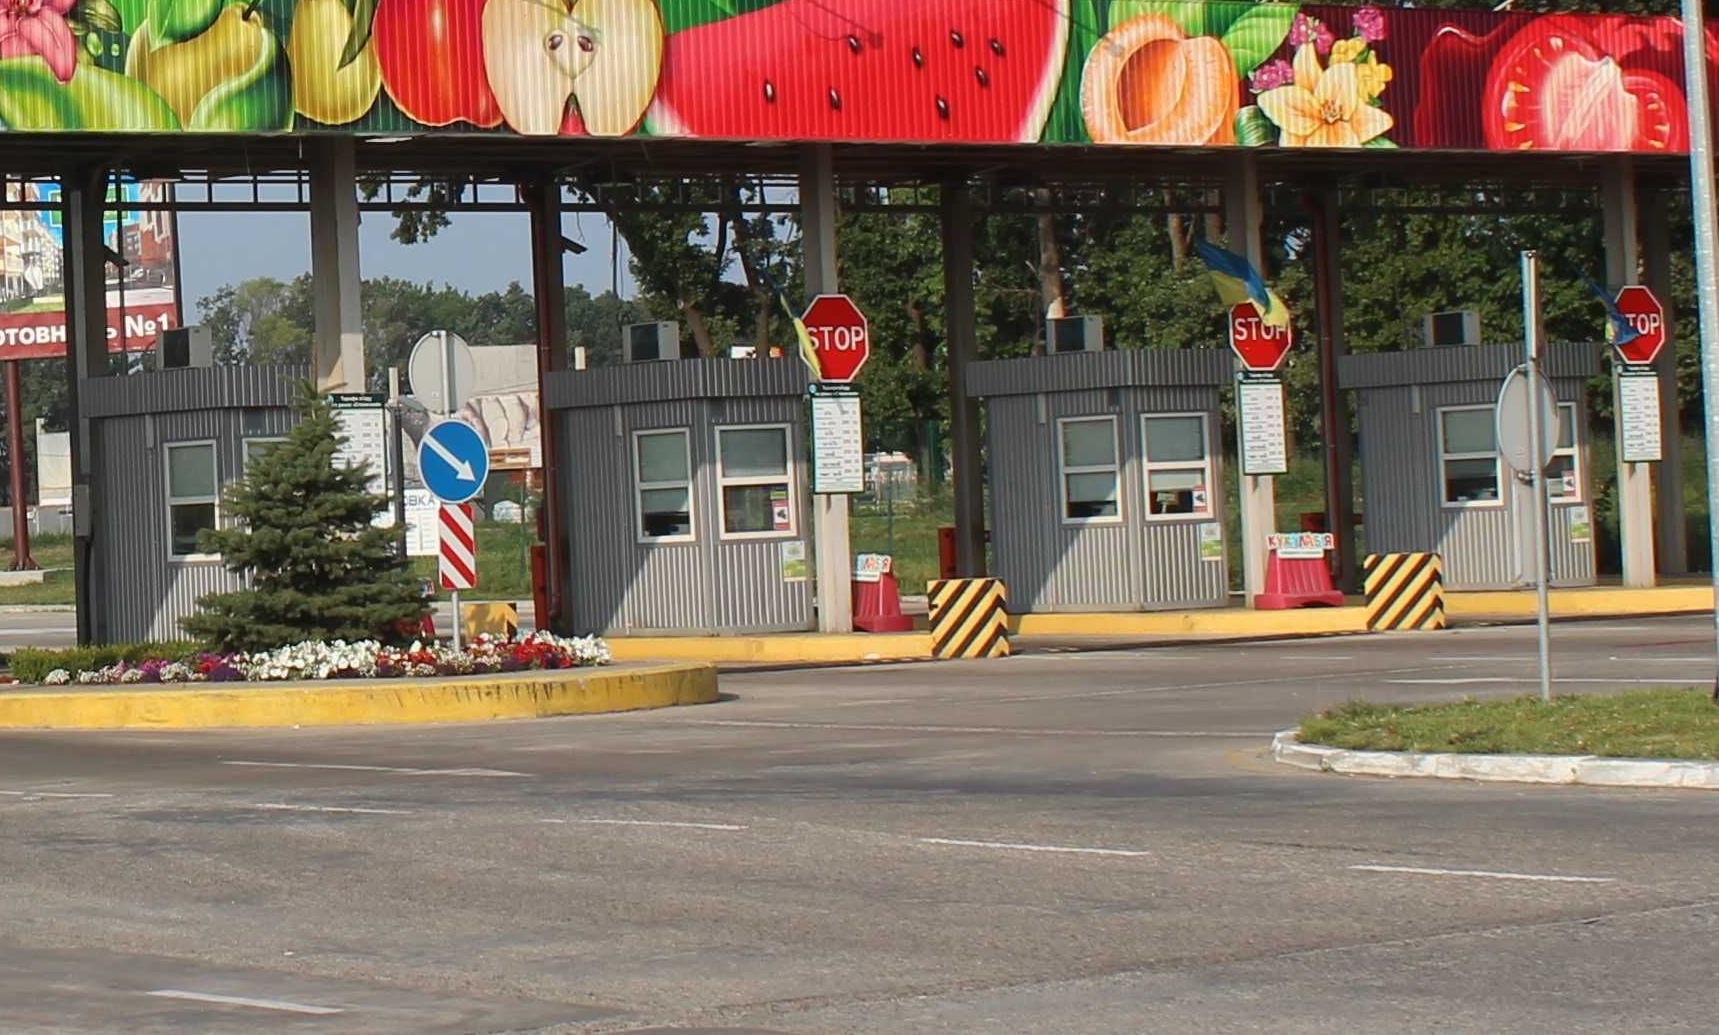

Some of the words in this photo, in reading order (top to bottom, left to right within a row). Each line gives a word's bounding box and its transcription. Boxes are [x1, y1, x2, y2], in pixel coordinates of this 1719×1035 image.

[125, 313, 169, 338] №1
[1625, 313, 1660, 335] TOP
[807, 326, 865, 351] STOP
